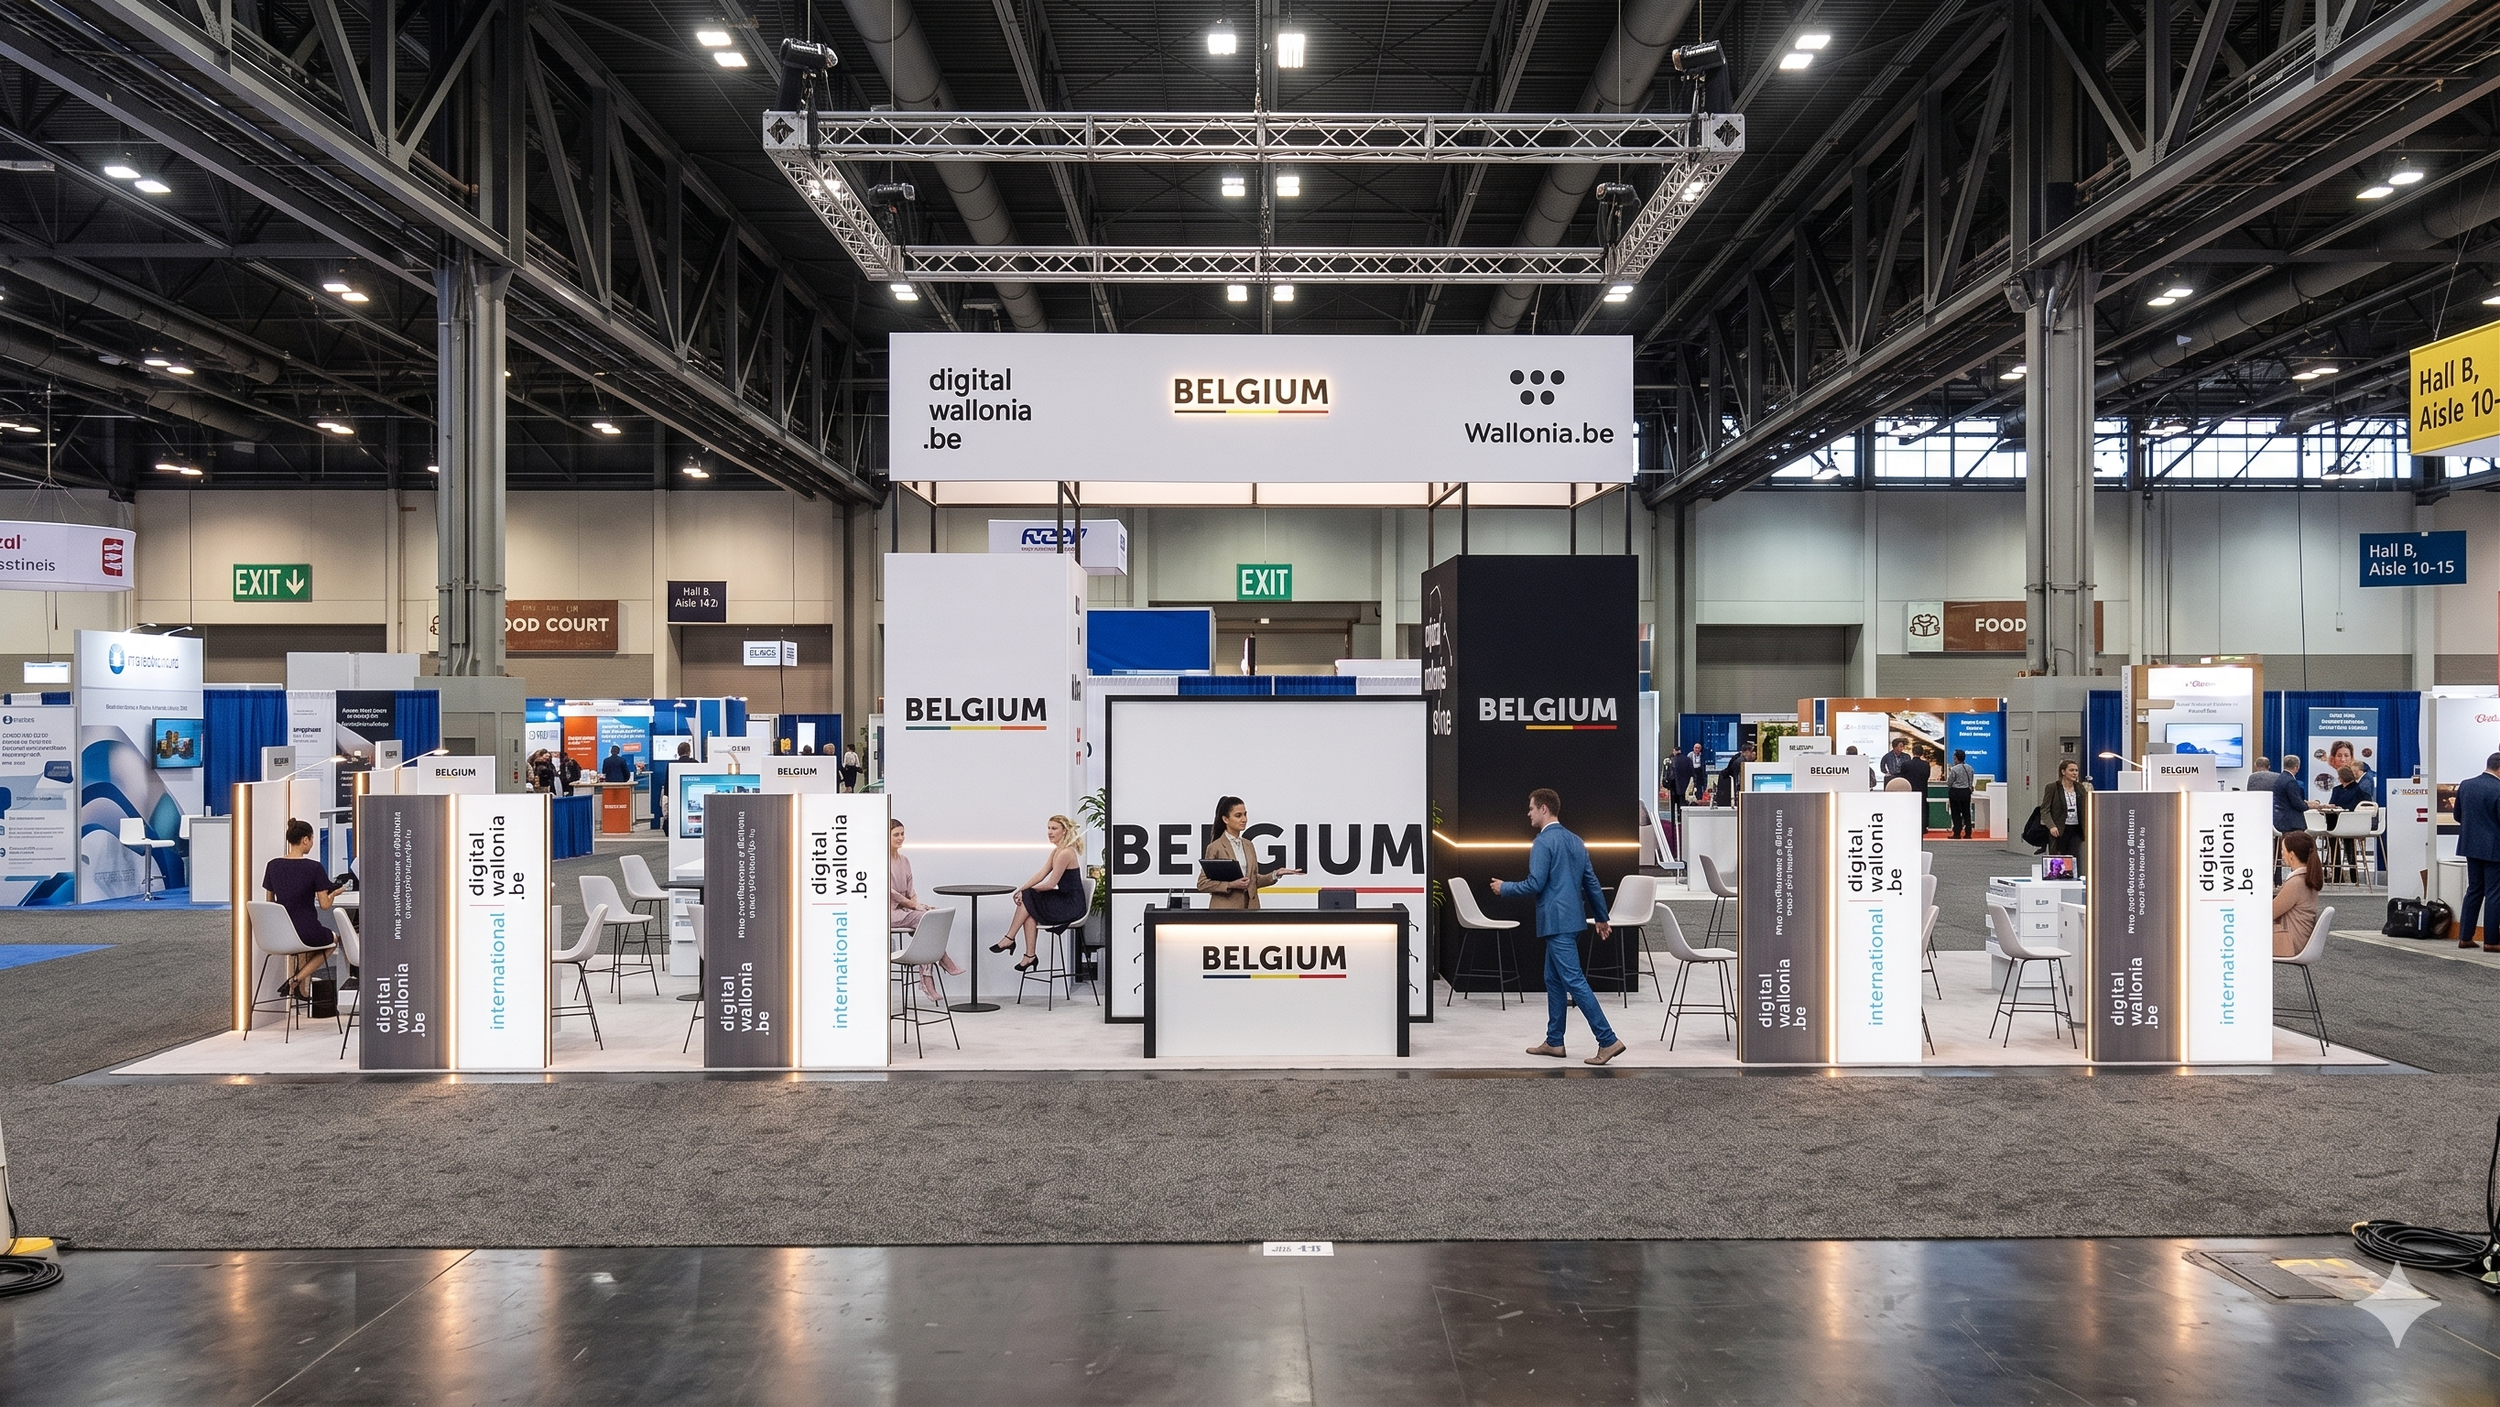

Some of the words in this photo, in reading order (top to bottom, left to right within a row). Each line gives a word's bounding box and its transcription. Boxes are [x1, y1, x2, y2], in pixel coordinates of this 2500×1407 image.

[930, 368, 1010, 397] digital
[2420, 359, 2454, 396] Hall
[2462, 356, 2479, 385] B,
[1175, 379, 1328, 404] BELGIUM
[929, 399, 1031, 421] wallonia
[2419, 397, 2464, 432] Aisle
[924, 427, 961, 449] .be
[1465, 422, 1613, 443] Wallonia.be
[2370, 543, 2398, 558] Hall
[2404, 543, 2417, 558] B,
[2369, 561, 2406, 576] Aisle
[2412, 560, 2454, 575] 10-15
[236, 570, 281, 595] EXIT
[683, 587, 700, 596] Hall
[1242, 570, 1288, 595] EXIT
[675, 598, 696, 608] Aisle
[546, 618, 609, 631] COURT
[1976, 618, 2026, 632] FOOD
[906, 698, 1046, 721] BELGIUM
[1480, 698, 1617, 721] BELGIUM
[469, 833, 488, 896] digital
[490, 816, 504, 896] wallonia
[811, 832, 830, 894] digital
[832, 815, 847, 895] wallonia
[1848, 830, 1866, 891] digital
[1868, 813, 1883, 892] wallonia
[2200, 830, 2217, 891] digital
[2220, 813, 2234, 891] wallonia
[509, 873, 524, 899] .be
[851, 872, 867, 898] .be
[1887, 869, 1902, 895] .be
[2238, 869, 2253, 895] .be
[490, 913, 504, 1029] international
[833, 912, 847, 1028] international
[1203, 946, 1346, 970] BELGIUM
[1869, 909, 1883, 1025] international
[2220, 908, 2234, 1024] international
[377, 978, 393, 1032] digital
[395, 964, 408, 1033] wallonia
[721, 975, 737, 1031] digital
[738, 963, 752, 1032] wallonia
[1758, 974, 1775, 1028] digital
[1776, 959, 1790, 1027] wallonia
[2129, 958, 2142, 1026] wallonia
[411, 1013, 425, 1037] .be
[756, 1012, 769, 1035] .be
[1793, 1007, 1806, 1030] .be
[2145, 1006, 2158, 1029] .be
